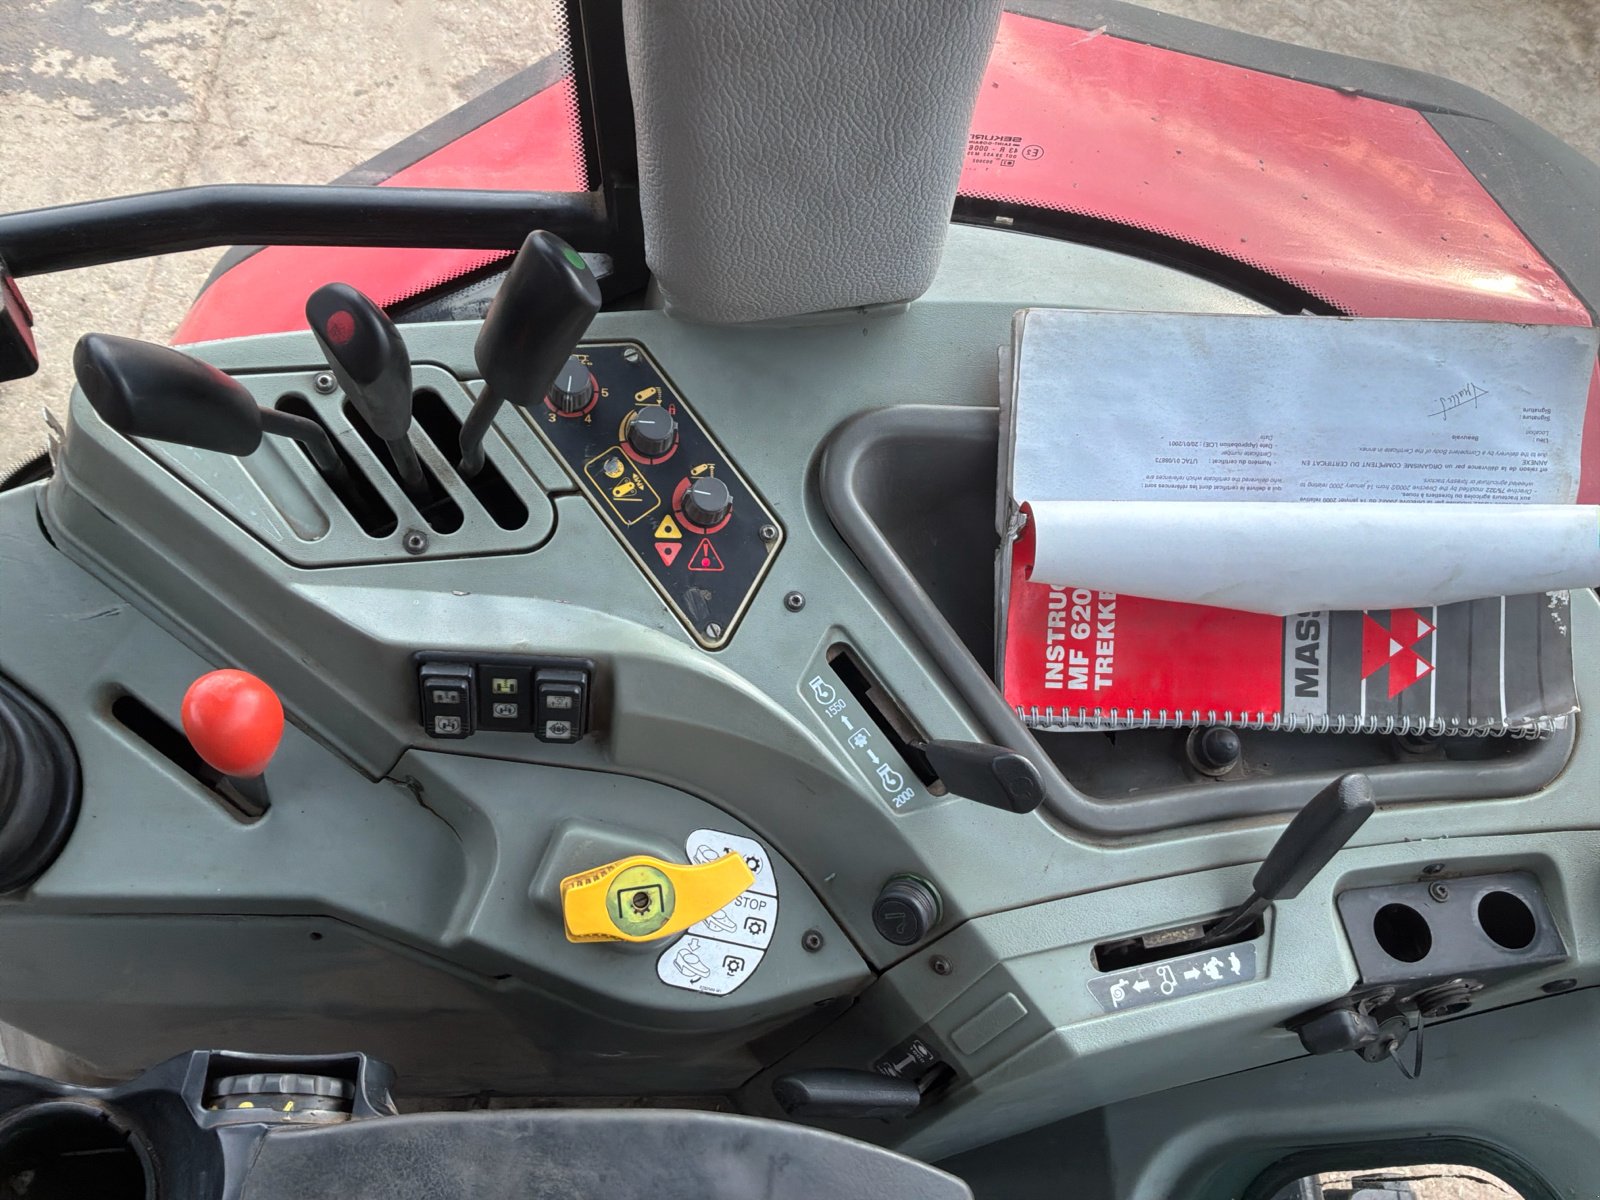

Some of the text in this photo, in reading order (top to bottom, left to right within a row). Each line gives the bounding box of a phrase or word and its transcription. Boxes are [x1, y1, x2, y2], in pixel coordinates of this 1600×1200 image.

[601, 388, 609, 397] 5
[548, 413, 592, 423] 3 4
[1295, 611, 1320, 697] MAS
[1068, 649, 1089, 690] MF
[825, 698, 847, 718] 1550
[892, 787, 915, 808] 2000
[734, 896, 767, 911] STOP
